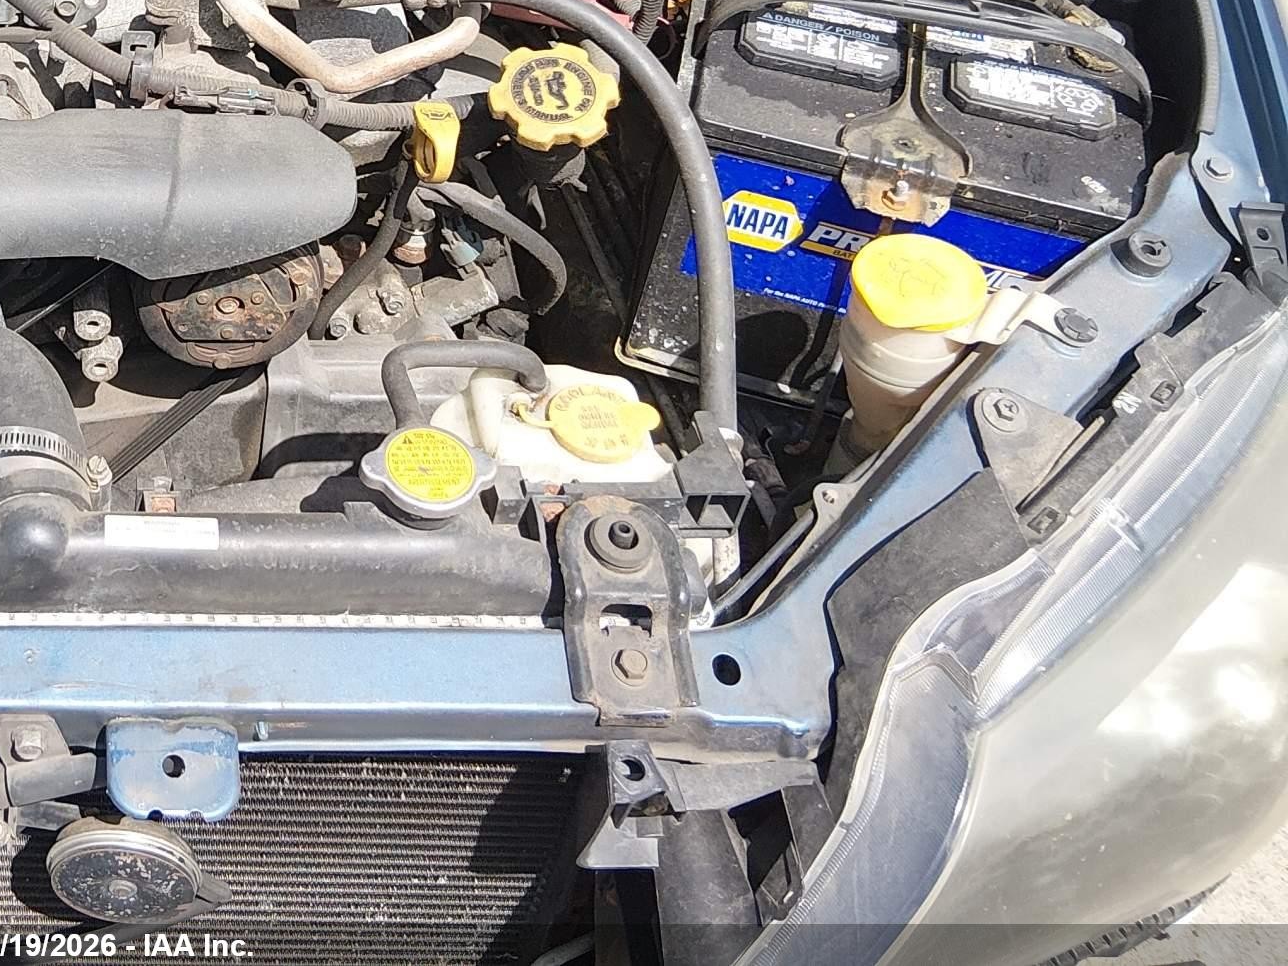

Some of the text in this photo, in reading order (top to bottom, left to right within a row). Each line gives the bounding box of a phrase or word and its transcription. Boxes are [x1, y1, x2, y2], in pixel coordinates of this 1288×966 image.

[774, 14, 824, 31] DANGER
[835, 26, 880, 42] POISON
[726, 203, 789, 241] NAPA
